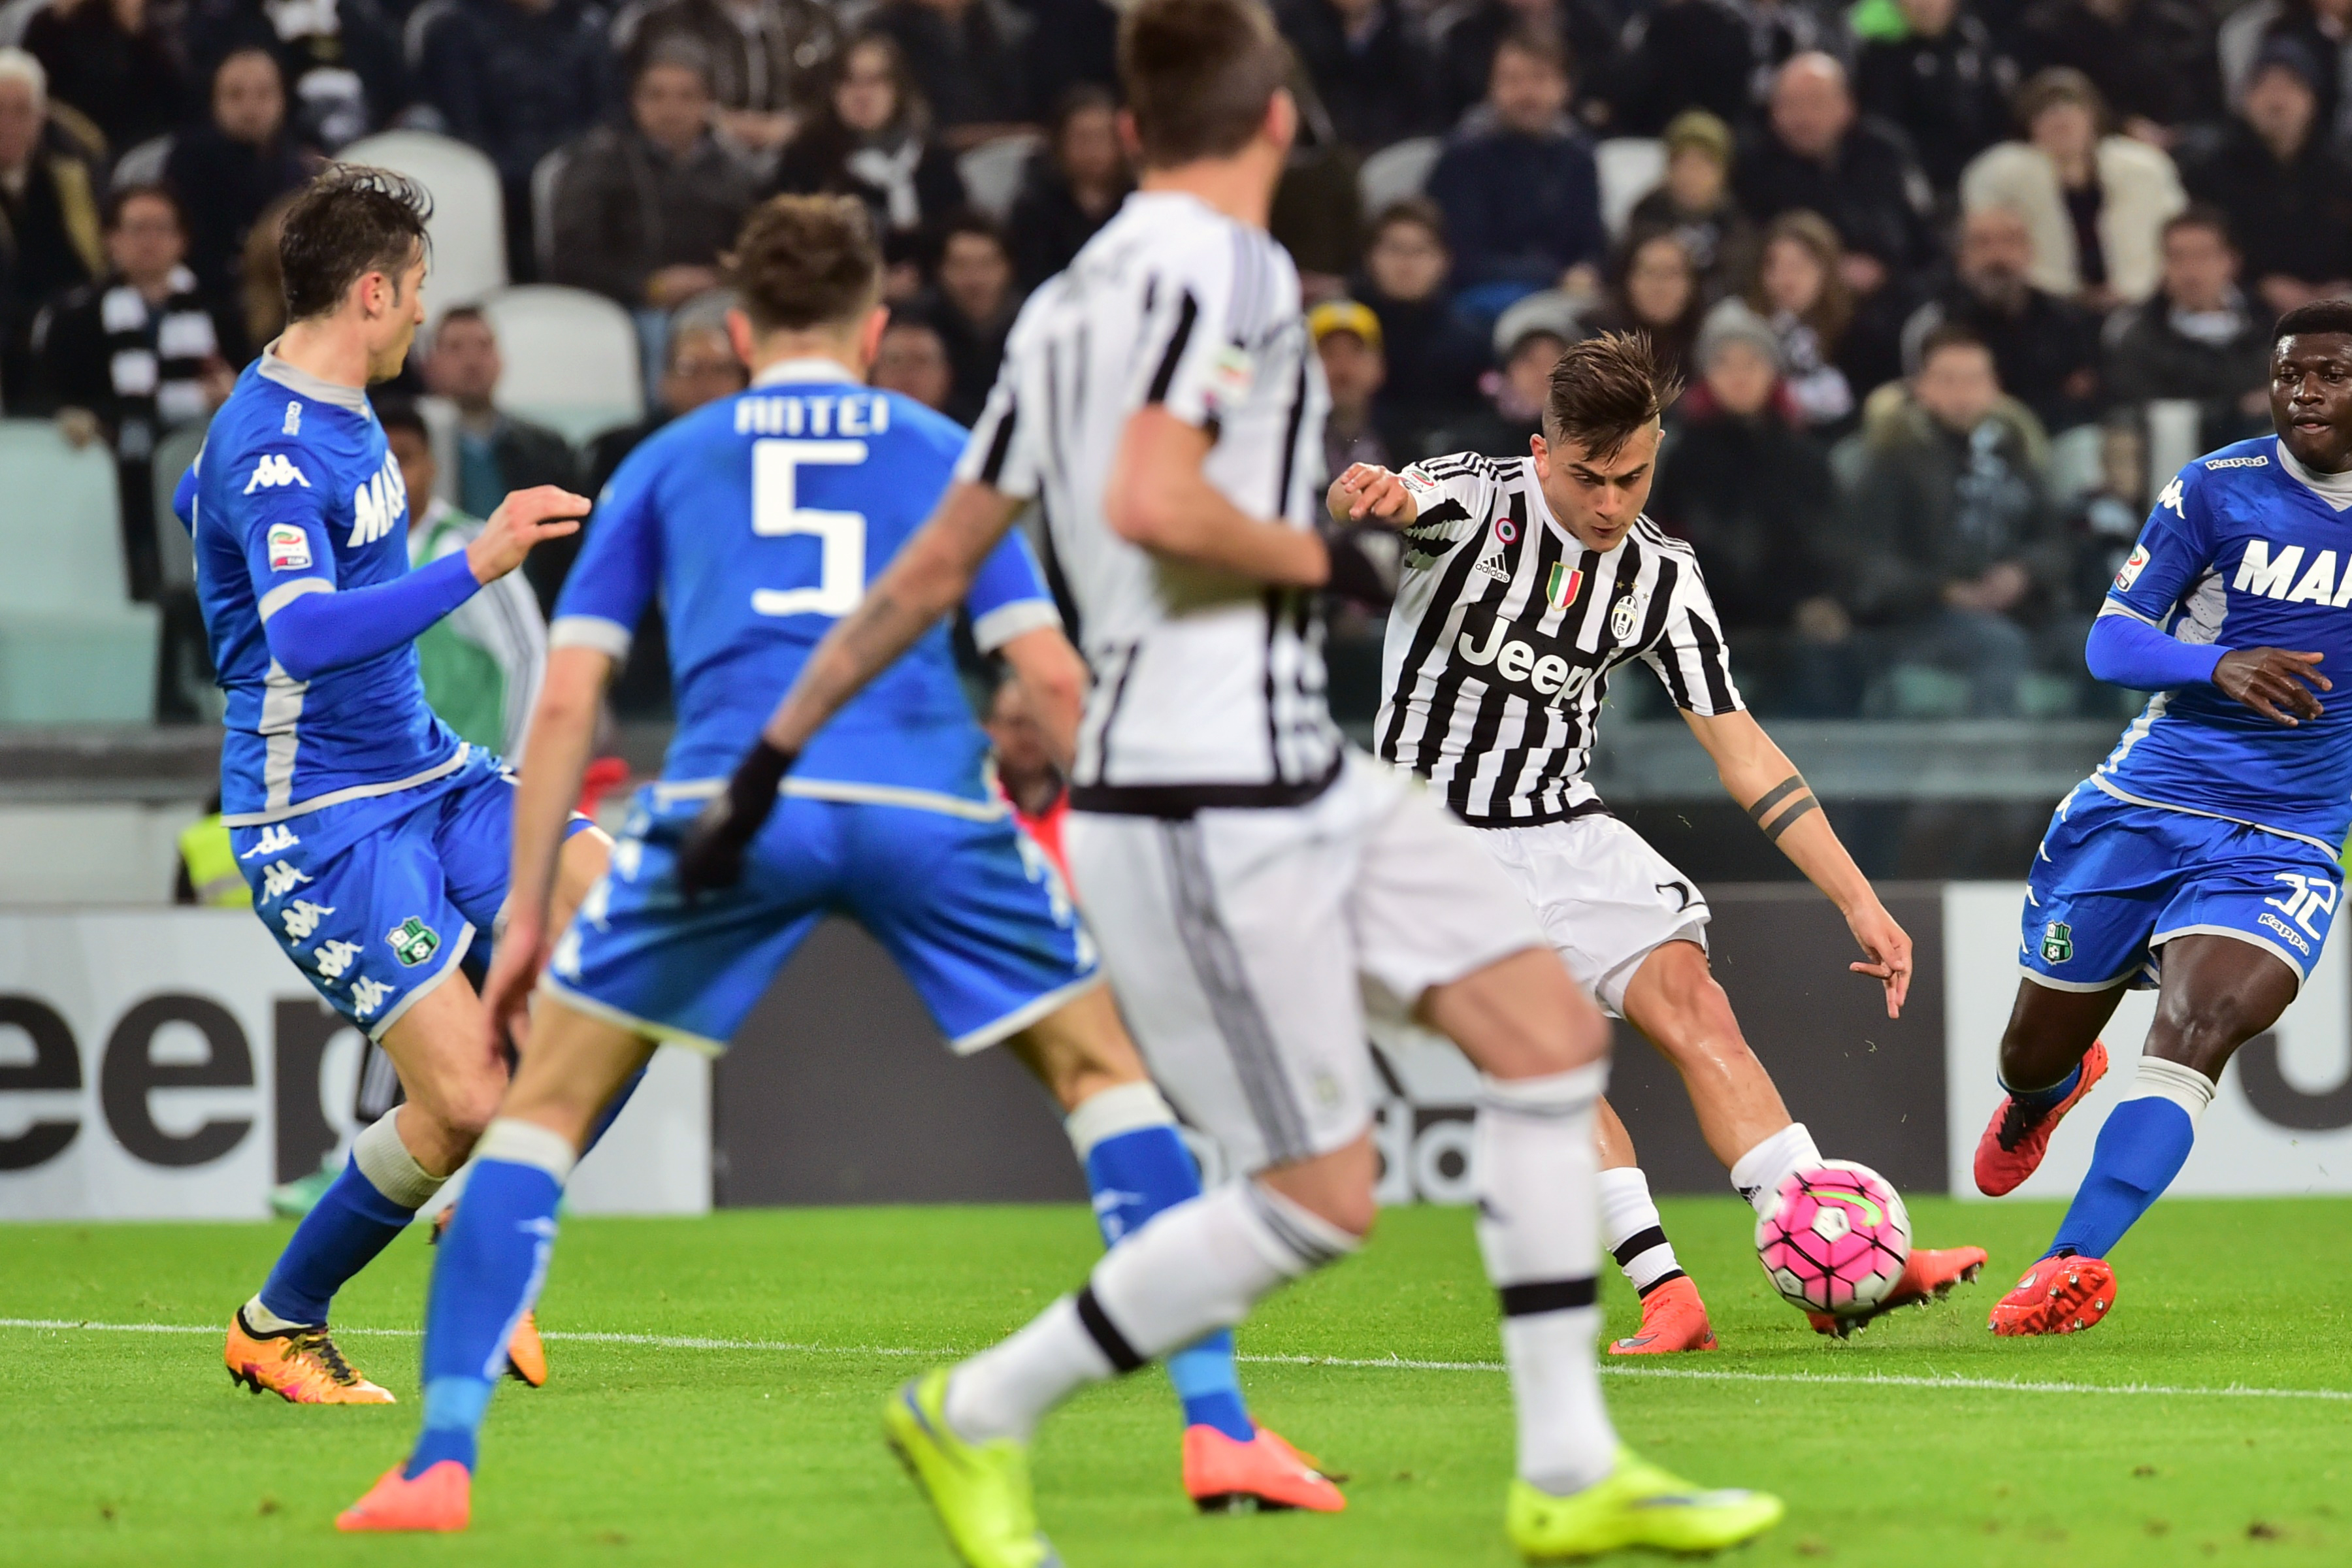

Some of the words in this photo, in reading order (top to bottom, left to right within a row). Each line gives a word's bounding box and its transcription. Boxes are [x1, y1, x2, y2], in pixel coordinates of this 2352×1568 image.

[734, 394, 890, 436] ANTEI
[2205, 456, 2269, 470] Kappa
[751, 438, 869, 617] 5
[1475, 563, 1510, 583] adidas
[2232, 540, 2352, 608] MA
[1458, 615, 1593, 708] Jeep
[2257, 913, 2310, 956] Kappa
[2264, 873, 2337, 941] 32
